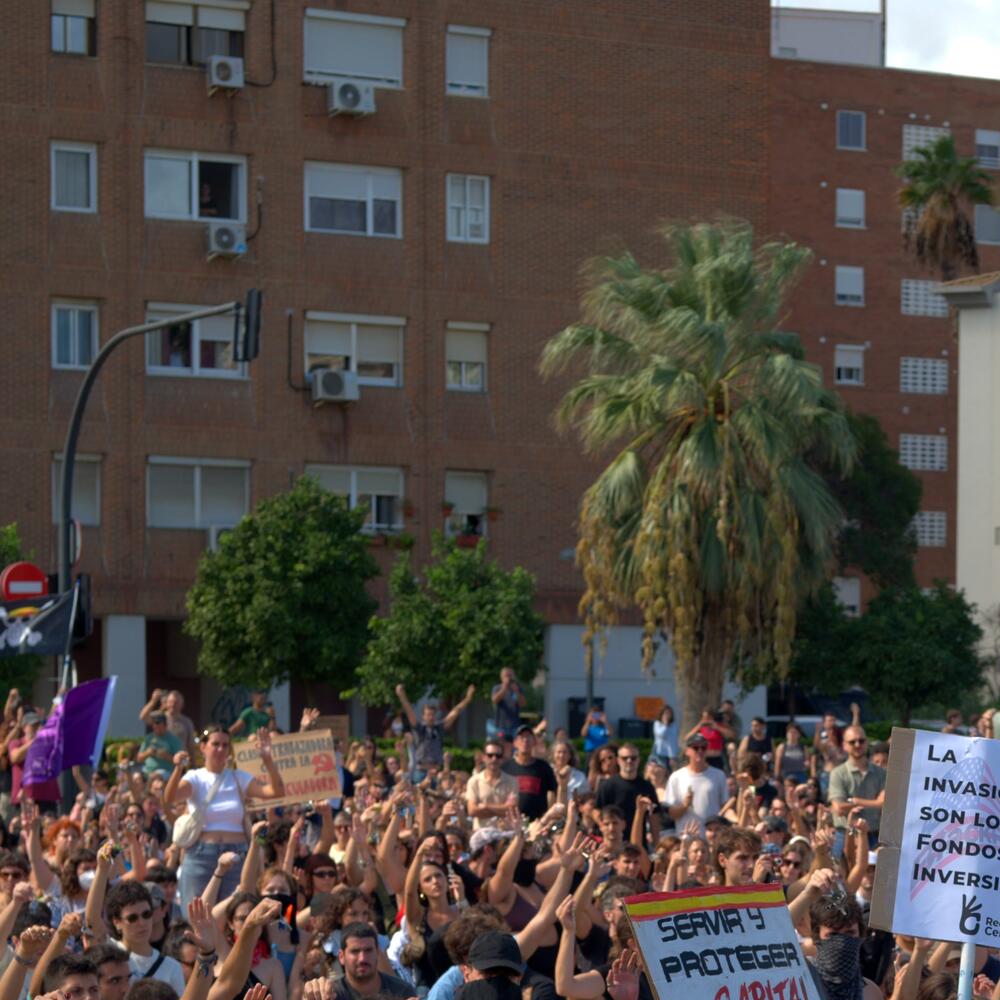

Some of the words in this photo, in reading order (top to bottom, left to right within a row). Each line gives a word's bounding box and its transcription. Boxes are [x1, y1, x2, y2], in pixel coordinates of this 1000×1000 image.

[927, 744, 957, 764] LA
[919, 806, 966, 825] SON
[657, 908, 745, 943] SERVIR
[659, 942, 801, 983] PROTEGER
